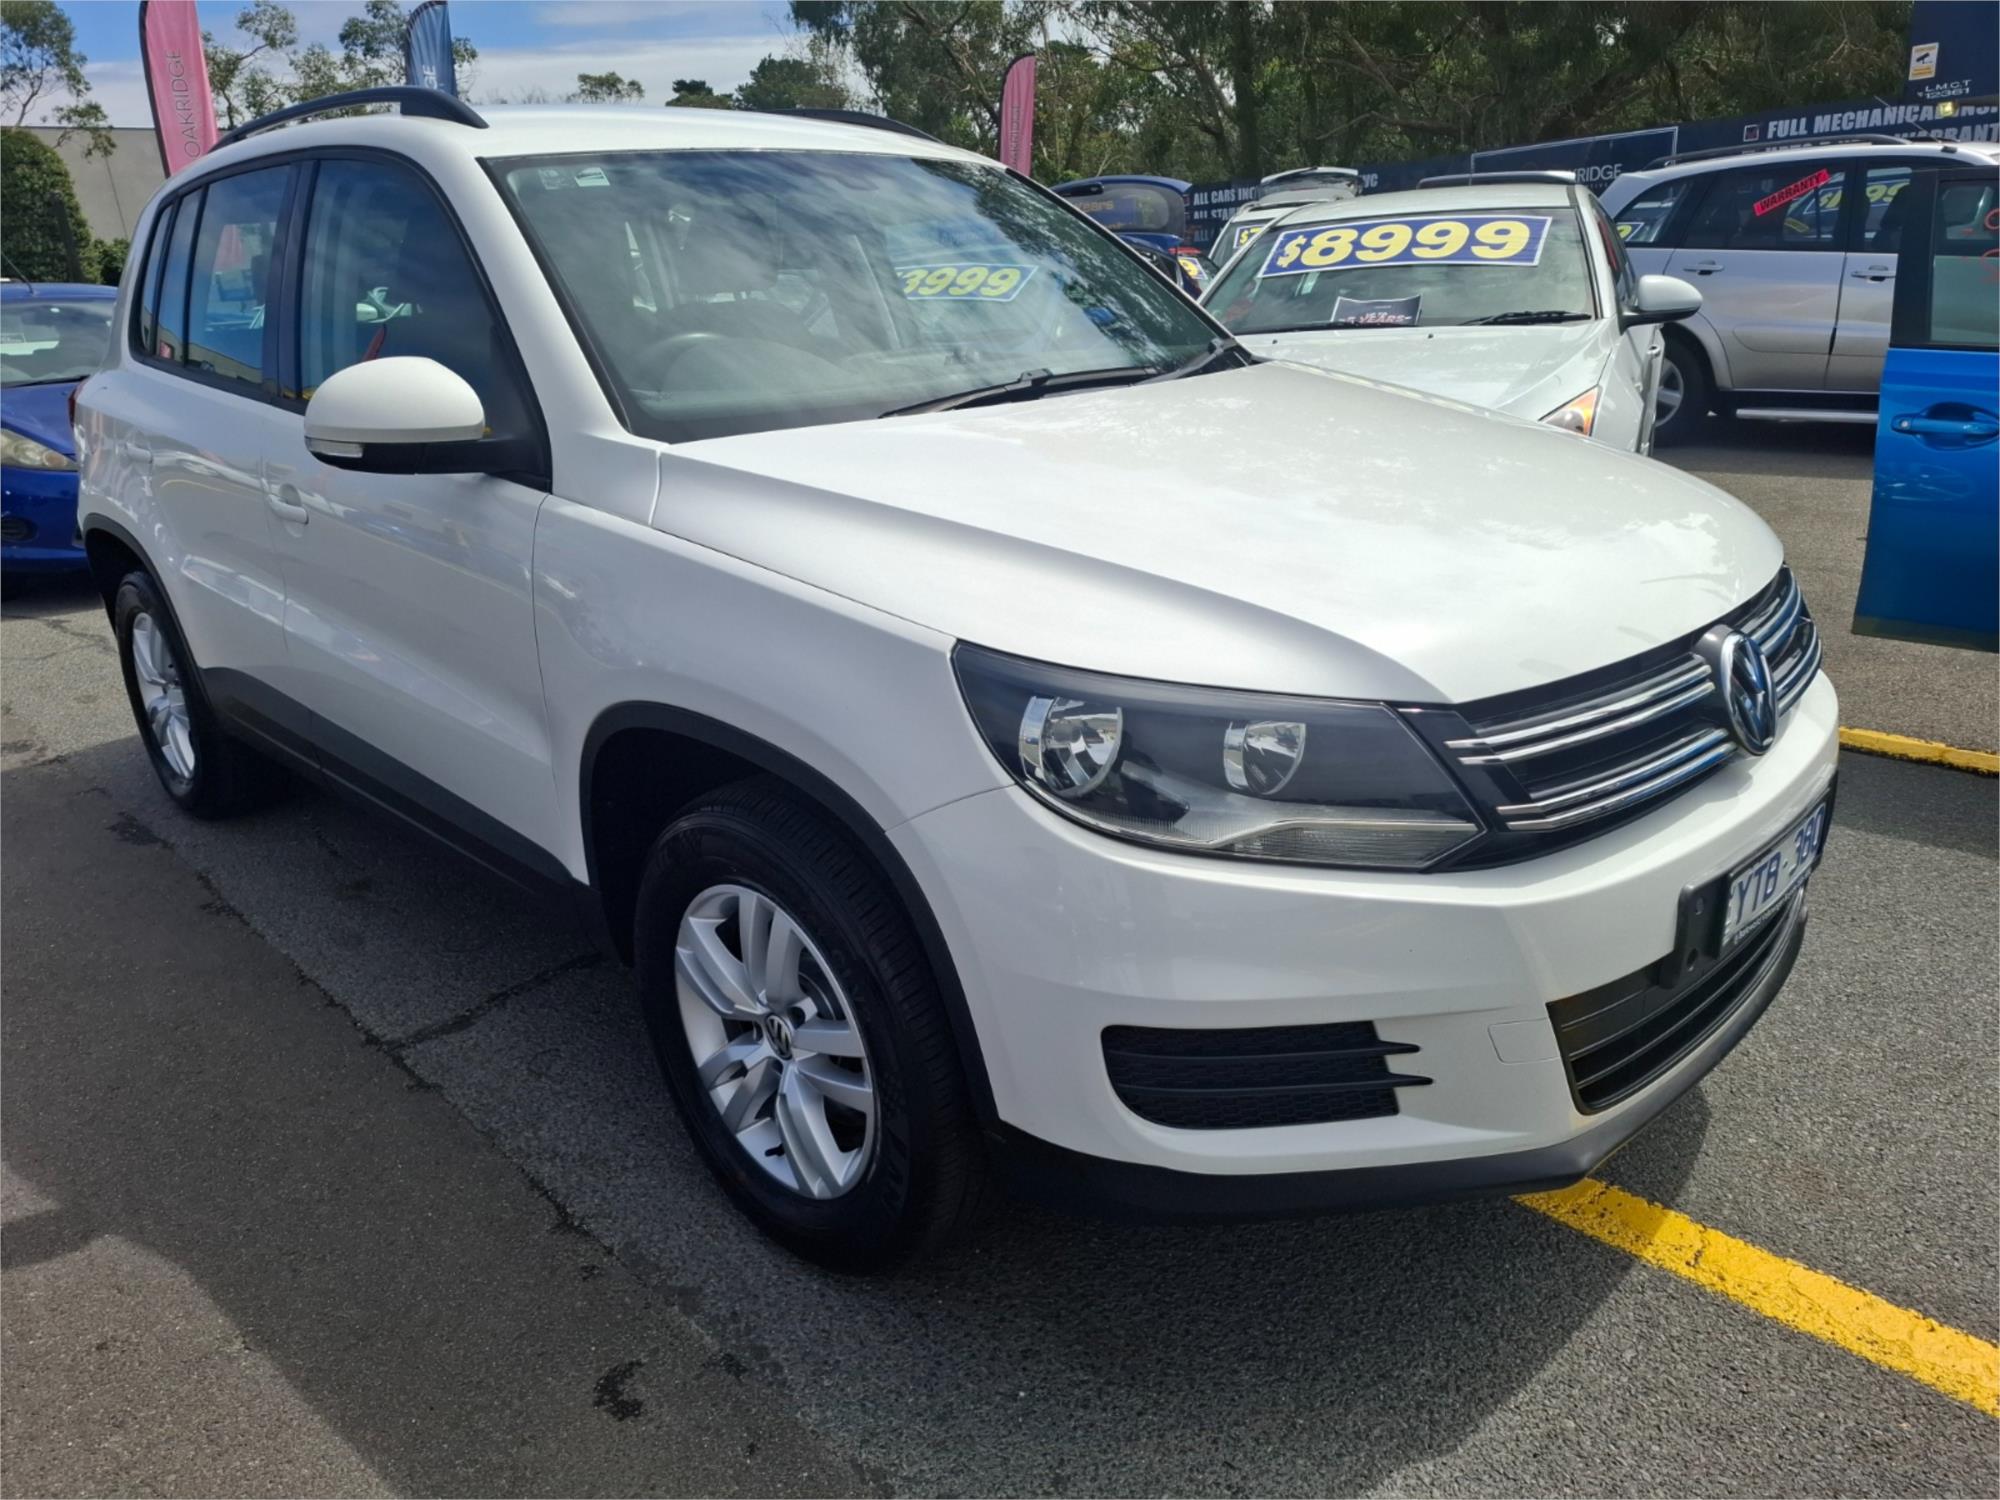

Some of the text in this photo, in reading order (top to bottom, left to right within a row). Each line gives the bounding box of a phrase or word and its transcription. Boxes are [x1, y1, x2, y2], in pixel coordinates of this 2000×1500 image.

[165, 48, 201, 158] OAKRIDGE
[1767, 117, 1807, 139] FULL
[1813, 105, 1948, 134] MECHANICAL
[1193, 191, 1210, 206] ALL
[1210, 188, 1236, 204] CARS
[1760, 171, 1821, 211] WARRANTY
[1275, 220, 1531, 268] $8999
